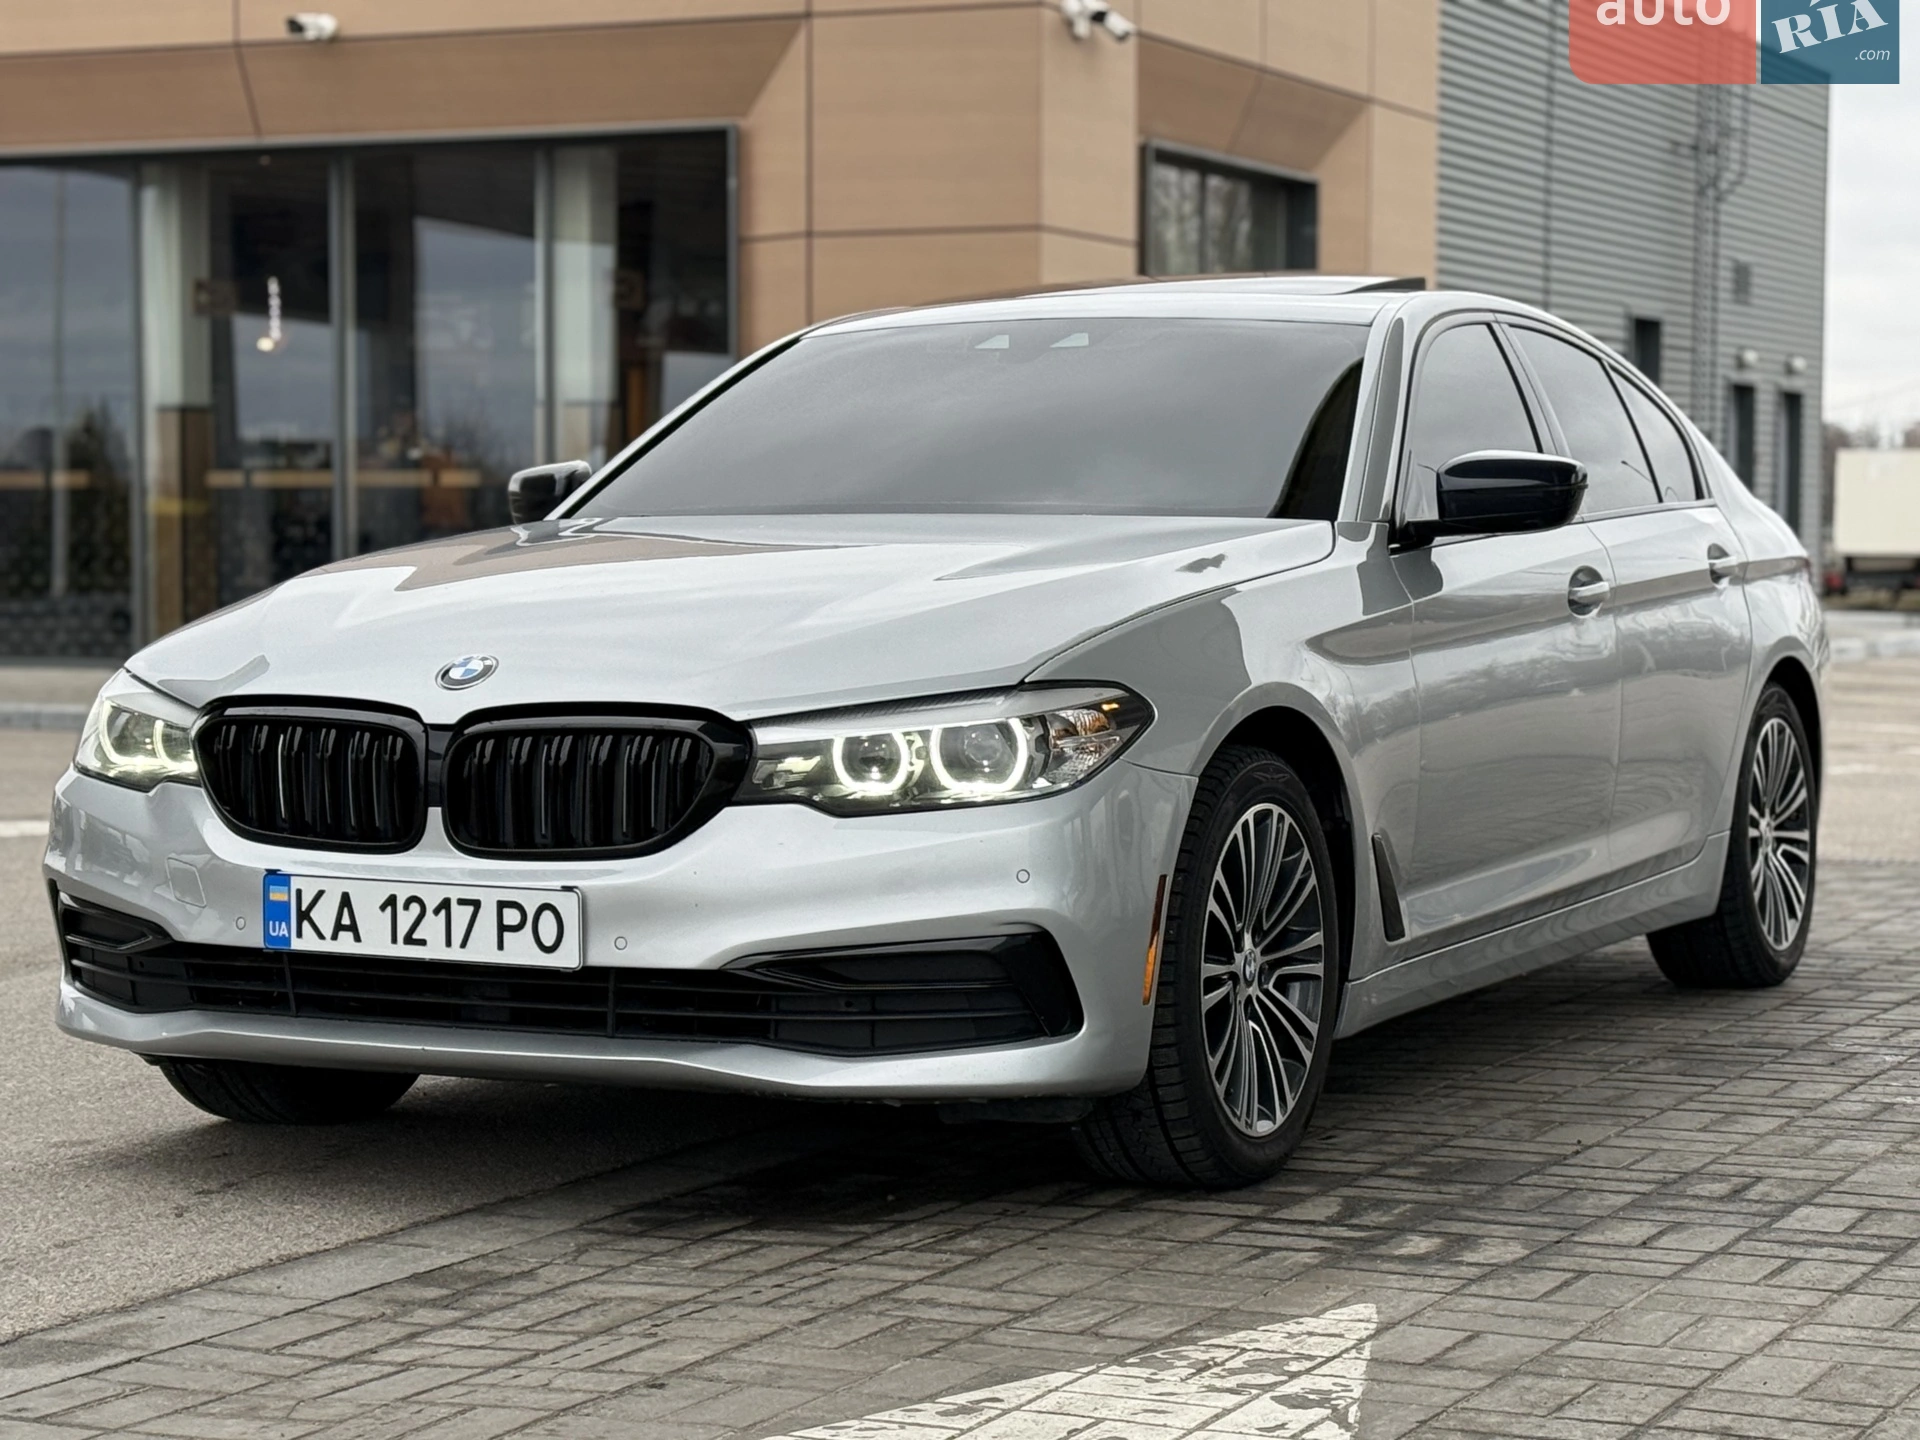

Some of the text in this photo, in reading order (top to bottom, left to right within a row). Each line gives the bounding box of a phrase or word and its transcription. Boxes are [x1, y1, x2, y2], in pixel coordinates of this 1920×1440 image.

[269, 920, 289, 938] UA
[295, 888, 565, 955] KA 1217 PO
